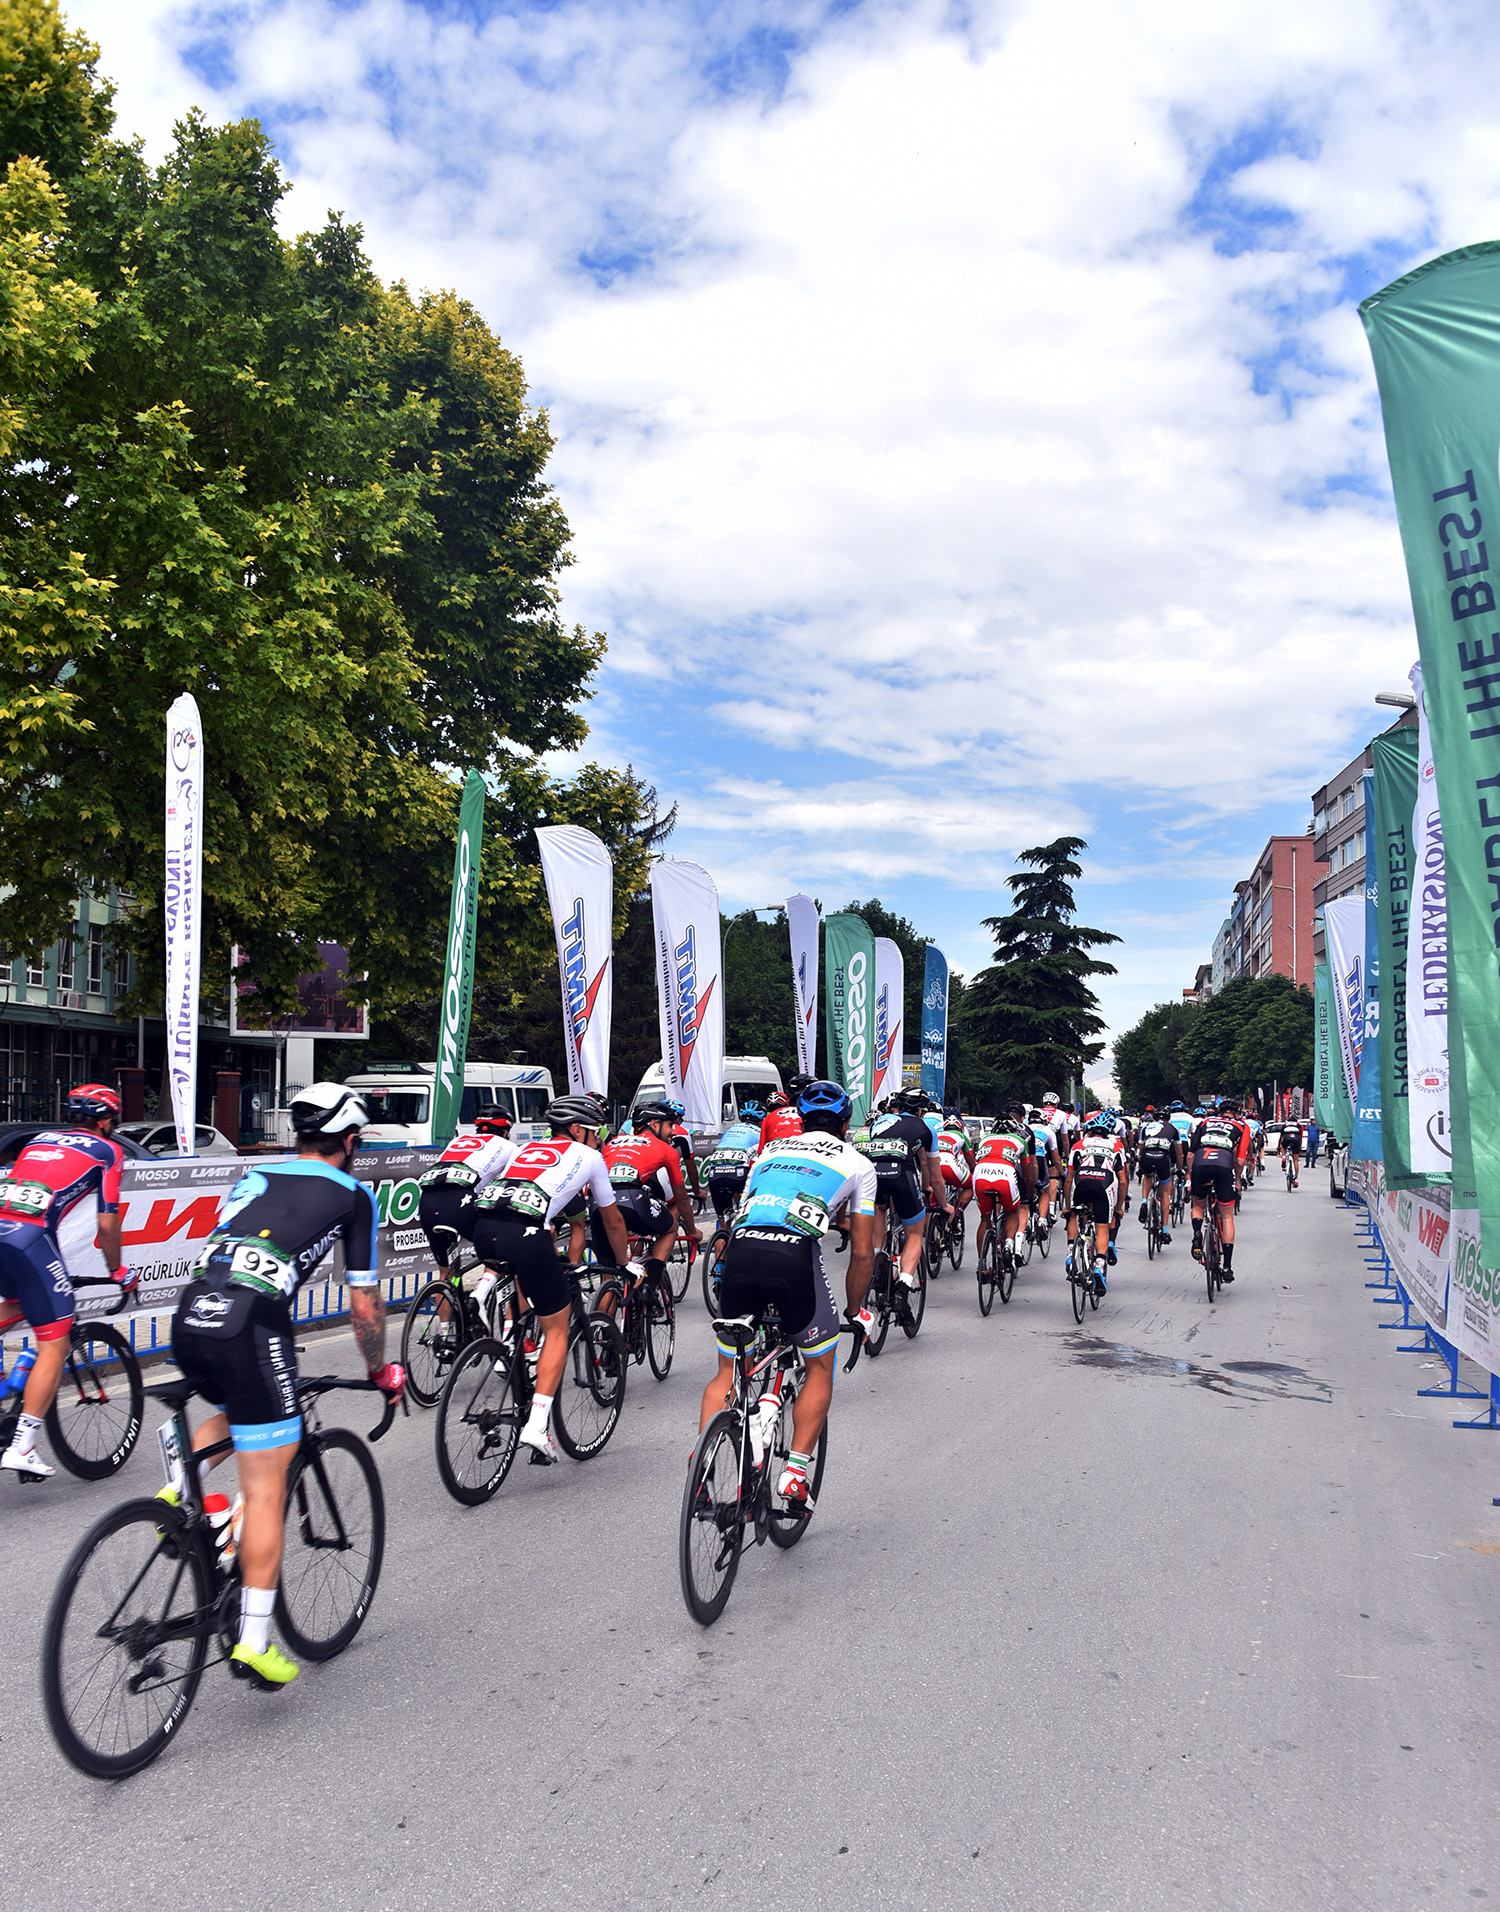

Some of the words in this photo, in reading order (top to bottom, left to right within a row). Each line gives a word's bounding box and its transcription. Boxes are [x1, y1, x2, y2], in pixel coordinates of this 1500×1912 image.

[467, 864, 476, 916] BEST
[464, 919, 474, 967] THE
[440, 828, 470, 1098] MOSSO
[456, 970, 472, 1077] PROBABLY
[713, 1151, 726, 1160] 75
[731, 1151, 744, 1160] 75
[870, 1142, 885, 1151] 94
[890, 1141, 906, 1152] 94
[353, 1157, 379, 1167] OSSO
[418, 1154, 441, 1163] MOSS
[134, 1169, 180, 1182] MOSSO
[453, 1169, 472, 1181] 81
[611, 1167, 636, 1177] 112
[980, 1168, 1005, 1176] IRAN
[18, 1188, 45, 1205] 53
[518, 1189, 543, 1209] 83
[798, 1205, 826, 1228] 61
[744, 1229, 803, 1244] GIANT
[298, 1224, 343, 1271] SWISS
[130, 1257, 192, 1283] ZGÜRLÜK
[243, 1250, 280, 1282] 92
